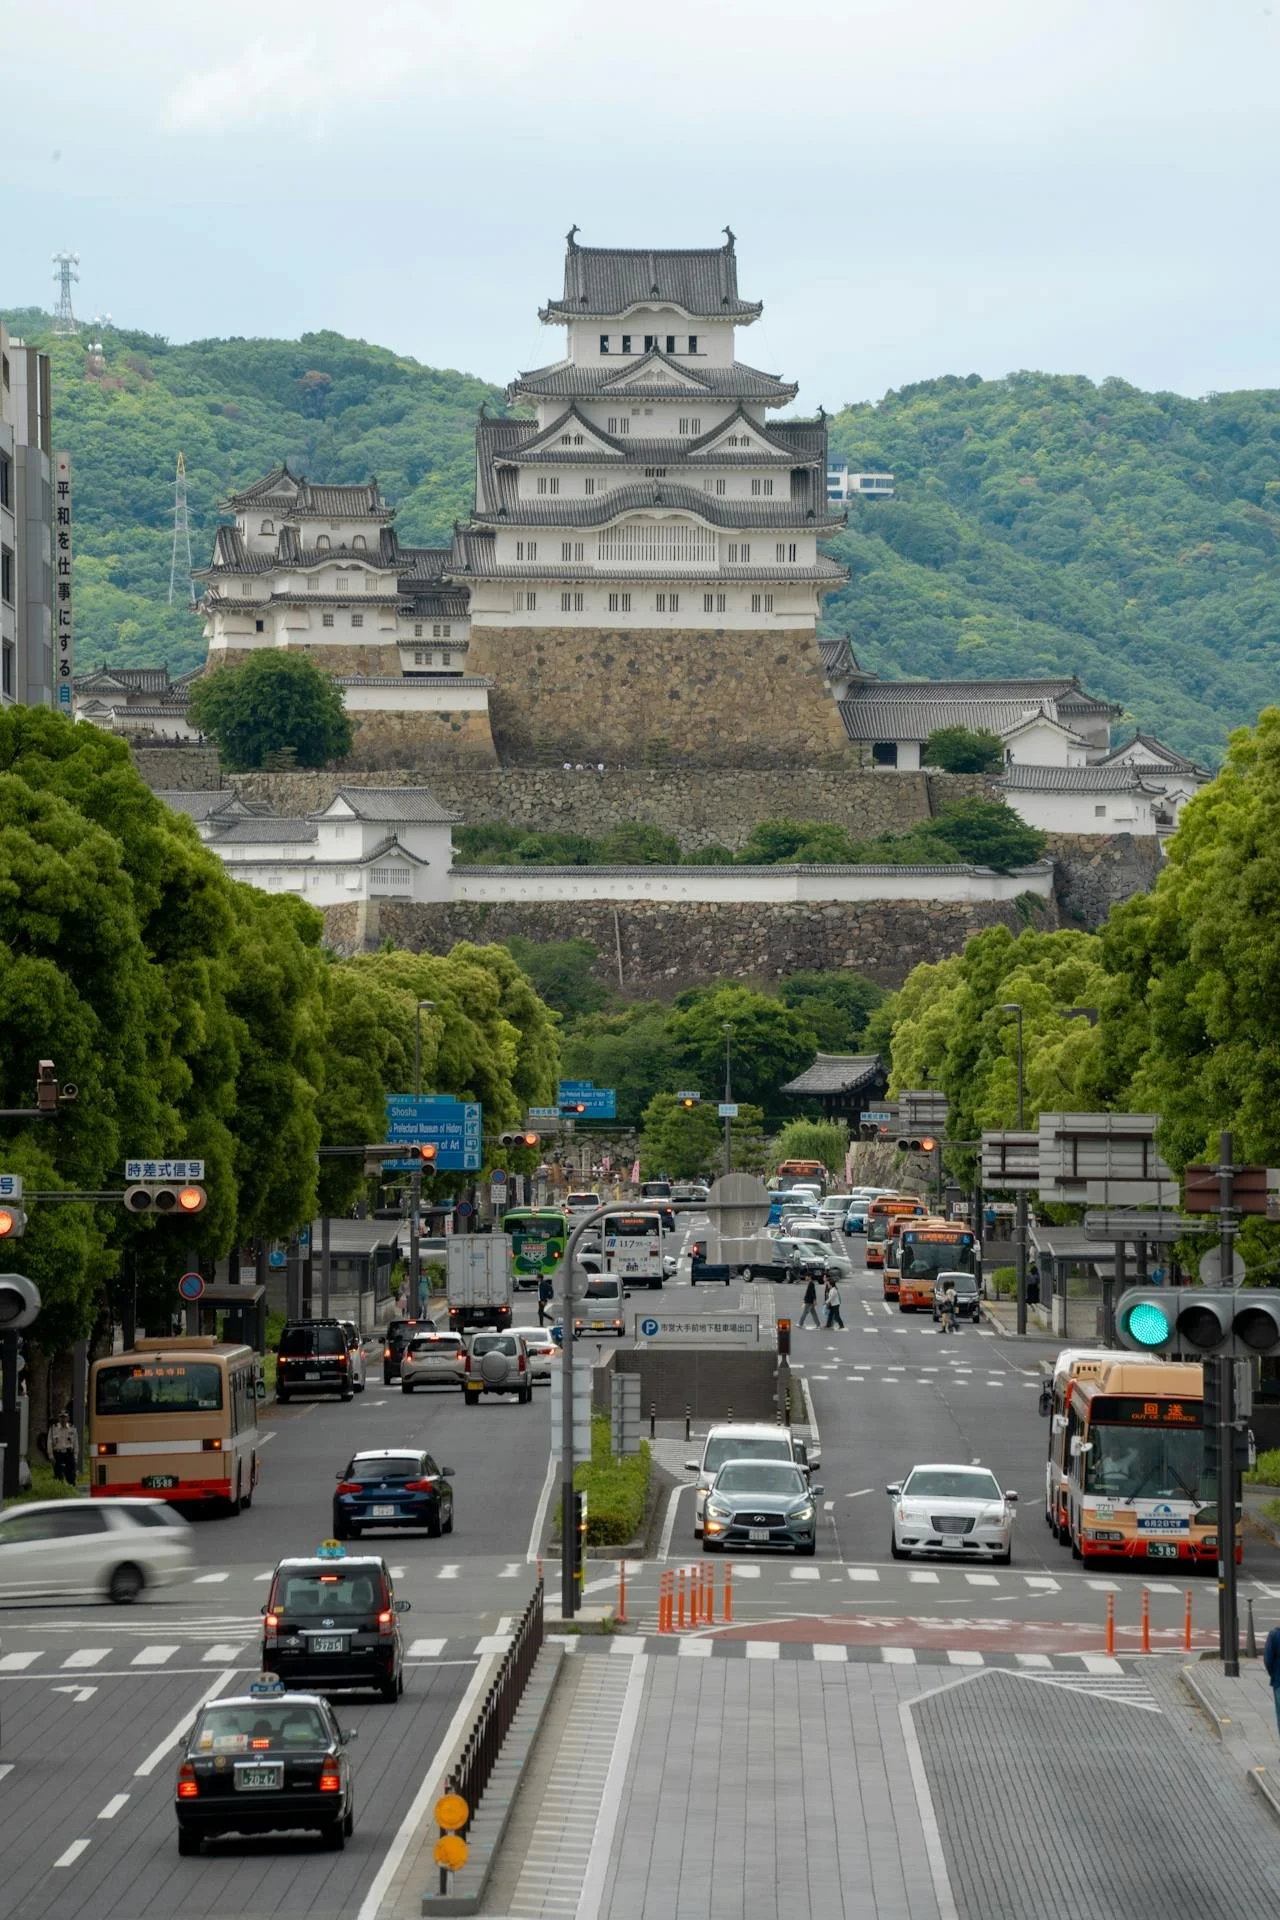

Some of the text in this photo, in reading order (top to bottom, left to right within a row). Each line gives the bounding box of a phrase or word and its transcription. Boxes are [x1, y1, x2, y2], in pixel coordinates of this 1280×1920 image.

[57, 481, 71, 677] 平和を仕事にする
[391, 1107, 417, 1117] Shosha
[441, 1140, 448, 1150] of
[450, 1140, 460, 1150] Art
[128, 1163, 201, 1177] 時差式信号
[661, 1323, 753, 1333] 市営大手前地下駐車場出口
[1144, 1403, 1183, 1416] 回送
[1144, 1519, 1182, 1528] 6月2日です
